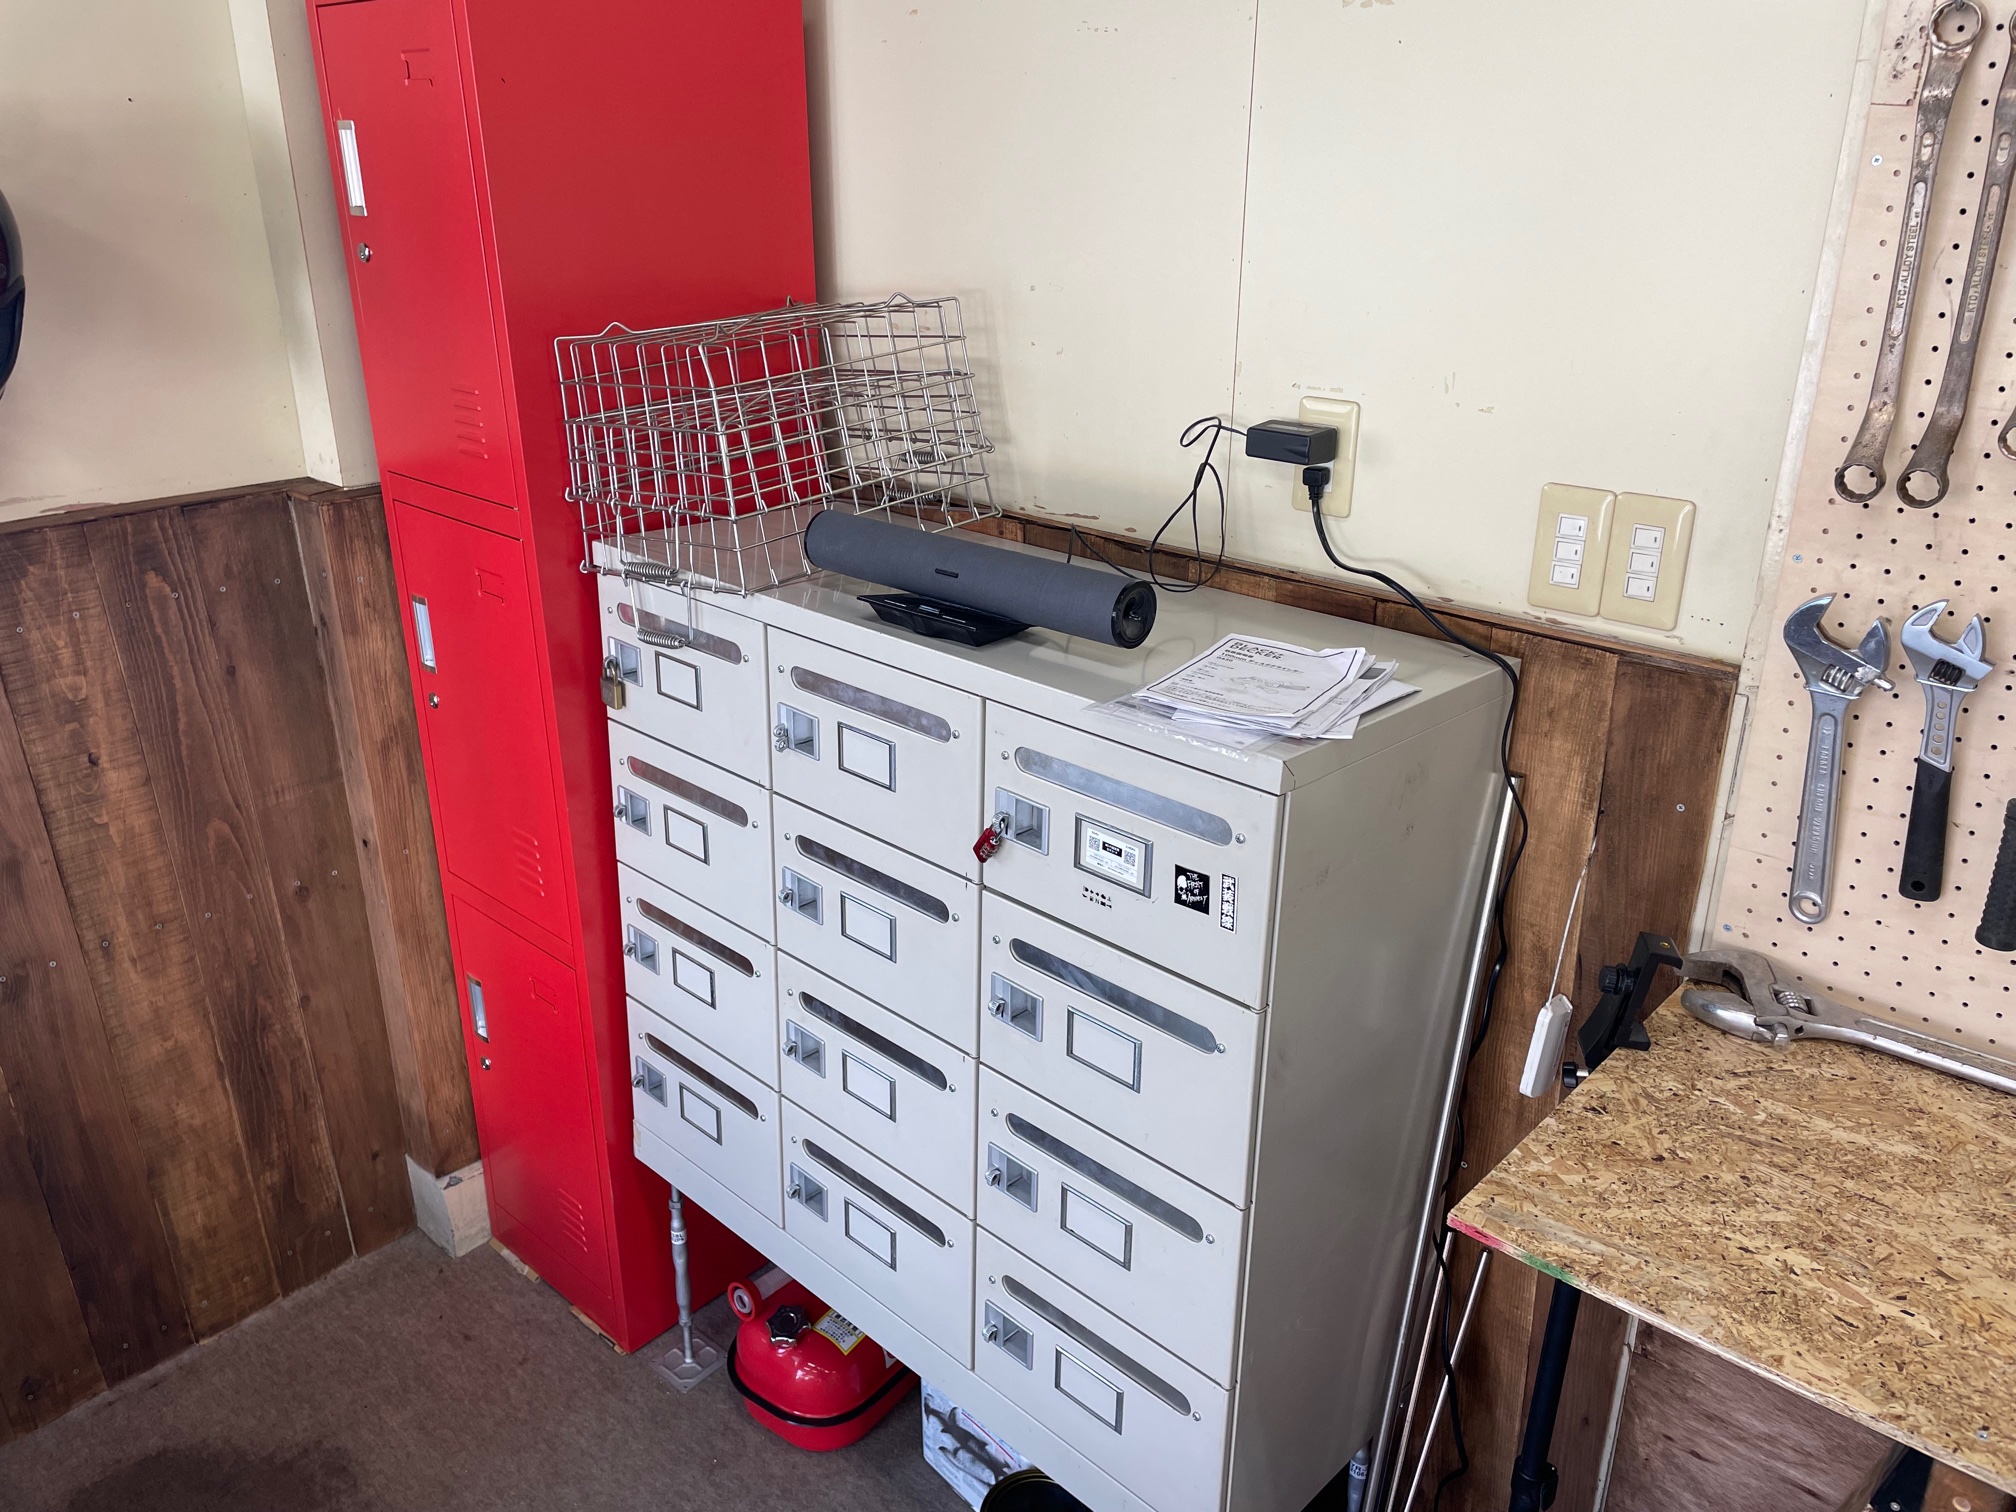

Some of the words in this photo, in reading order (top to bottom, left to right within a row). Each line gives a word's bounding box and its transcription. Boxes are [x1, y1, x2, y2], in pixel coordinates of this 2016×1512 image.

[1906, 222, 1919, 251] STEEL
[1901, 253, 1912, 284] ALLOY
[1971, 260, 1985, 288] ALLOY
[1229, 644, 1282, 660] DECKER
